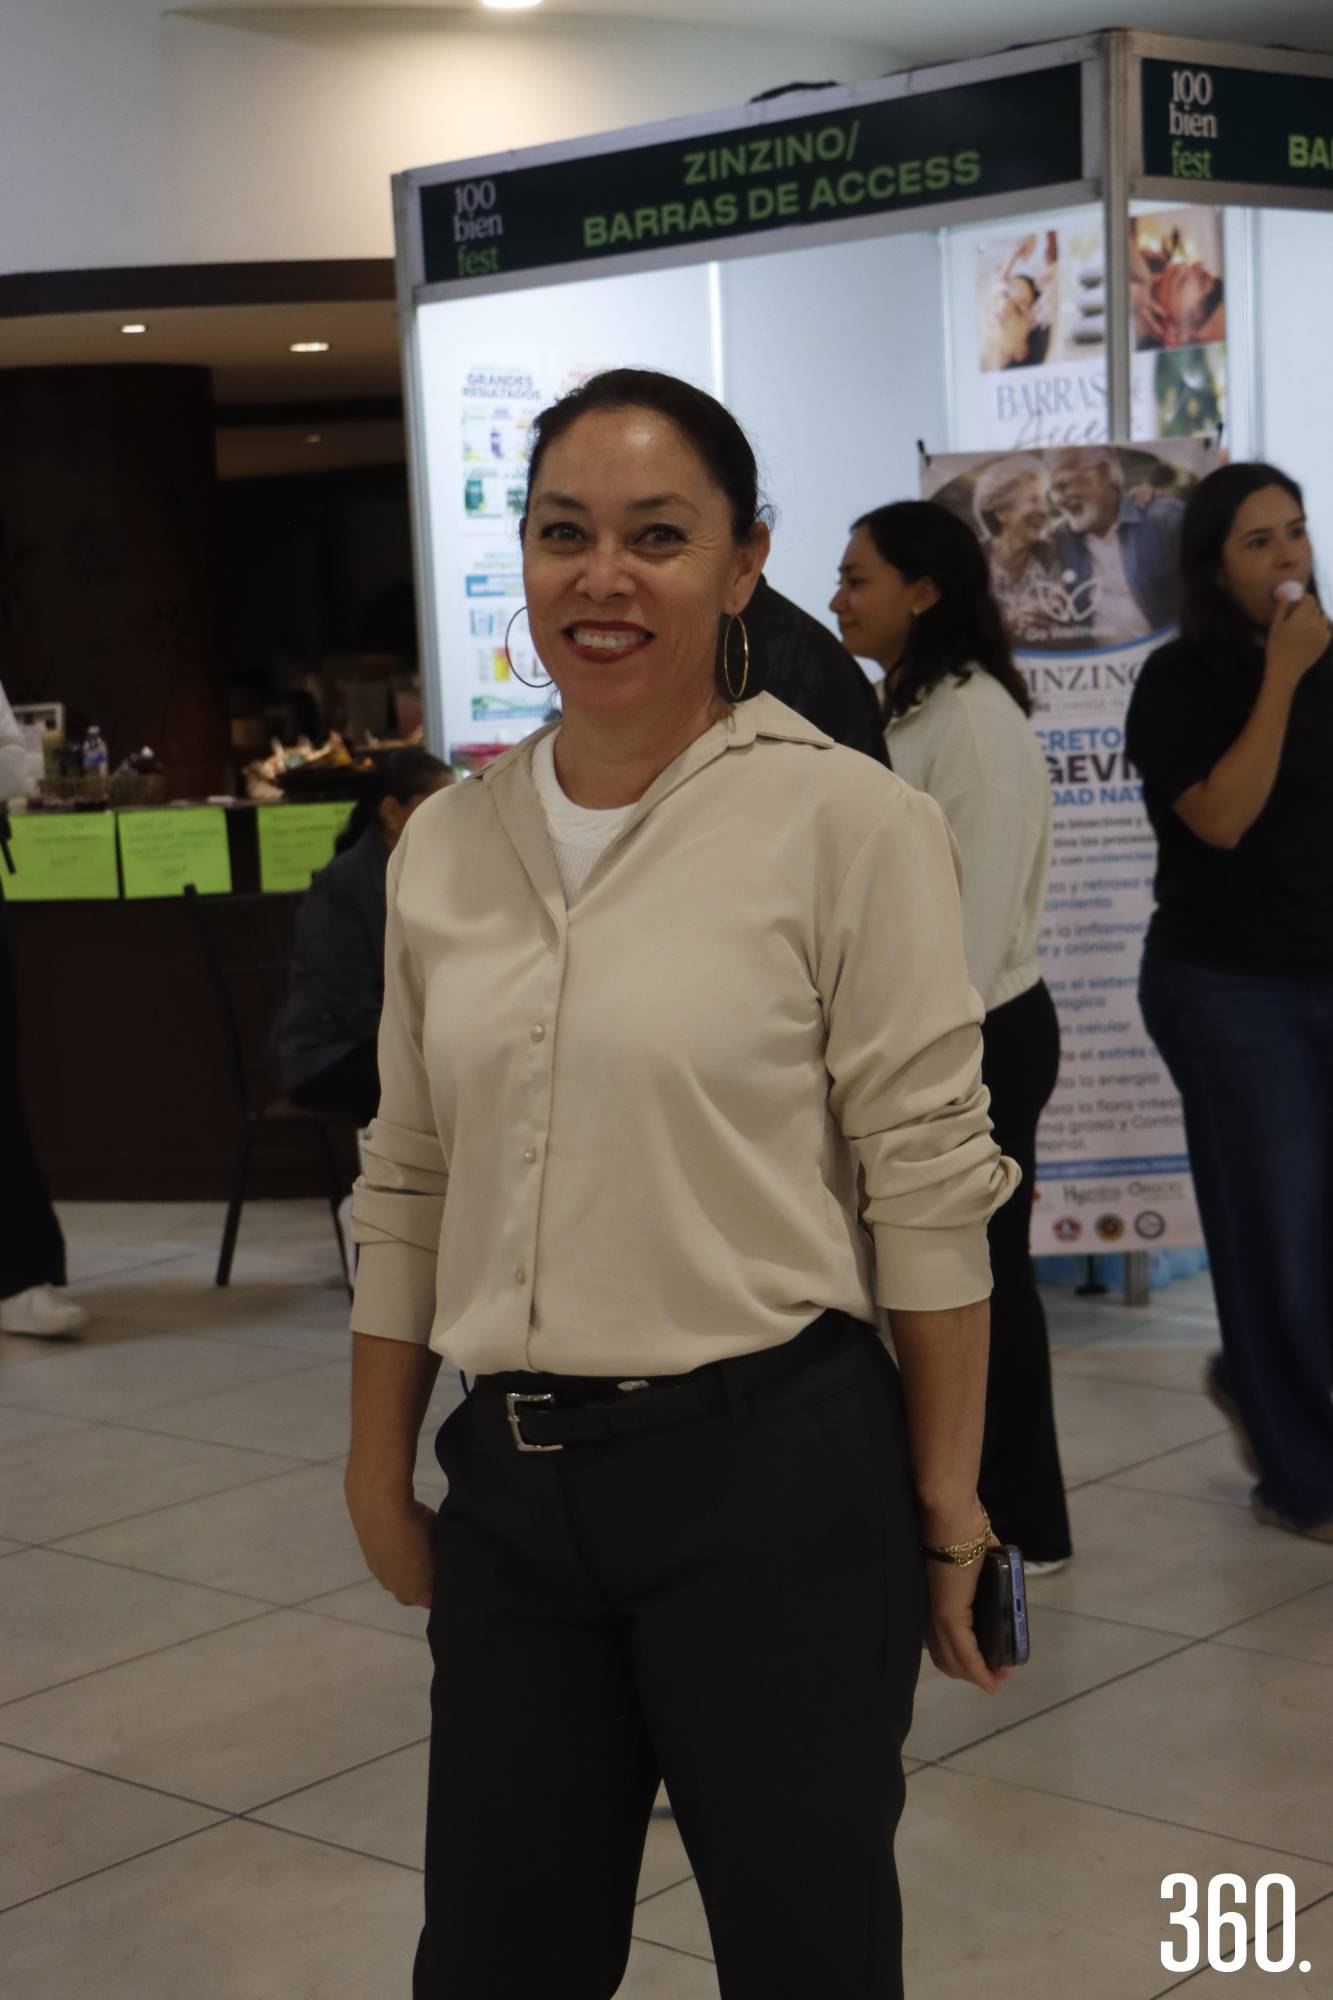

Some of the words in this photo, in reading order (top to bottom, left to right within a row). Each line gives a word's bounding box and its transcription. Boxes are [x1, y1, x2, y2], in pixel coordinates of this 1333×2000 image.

[1171, 70, 1213, 105] 100
[1168, 103, 1218, 139] bien
[682, 119, 861, 187] ZINZINO/
[1172, 139, 1213, 179] fest
[1288, 134, 1333, 170] BA
[454, 180, 497, 214] 100
[582, 192, 738, 249] BARRAS
[748, 182, 800, 221] DE
[808, 150, 982, 211] ACCESS
[453, 213, 504, 241] bien
[1029, 662, 1138, 693] INZIN
